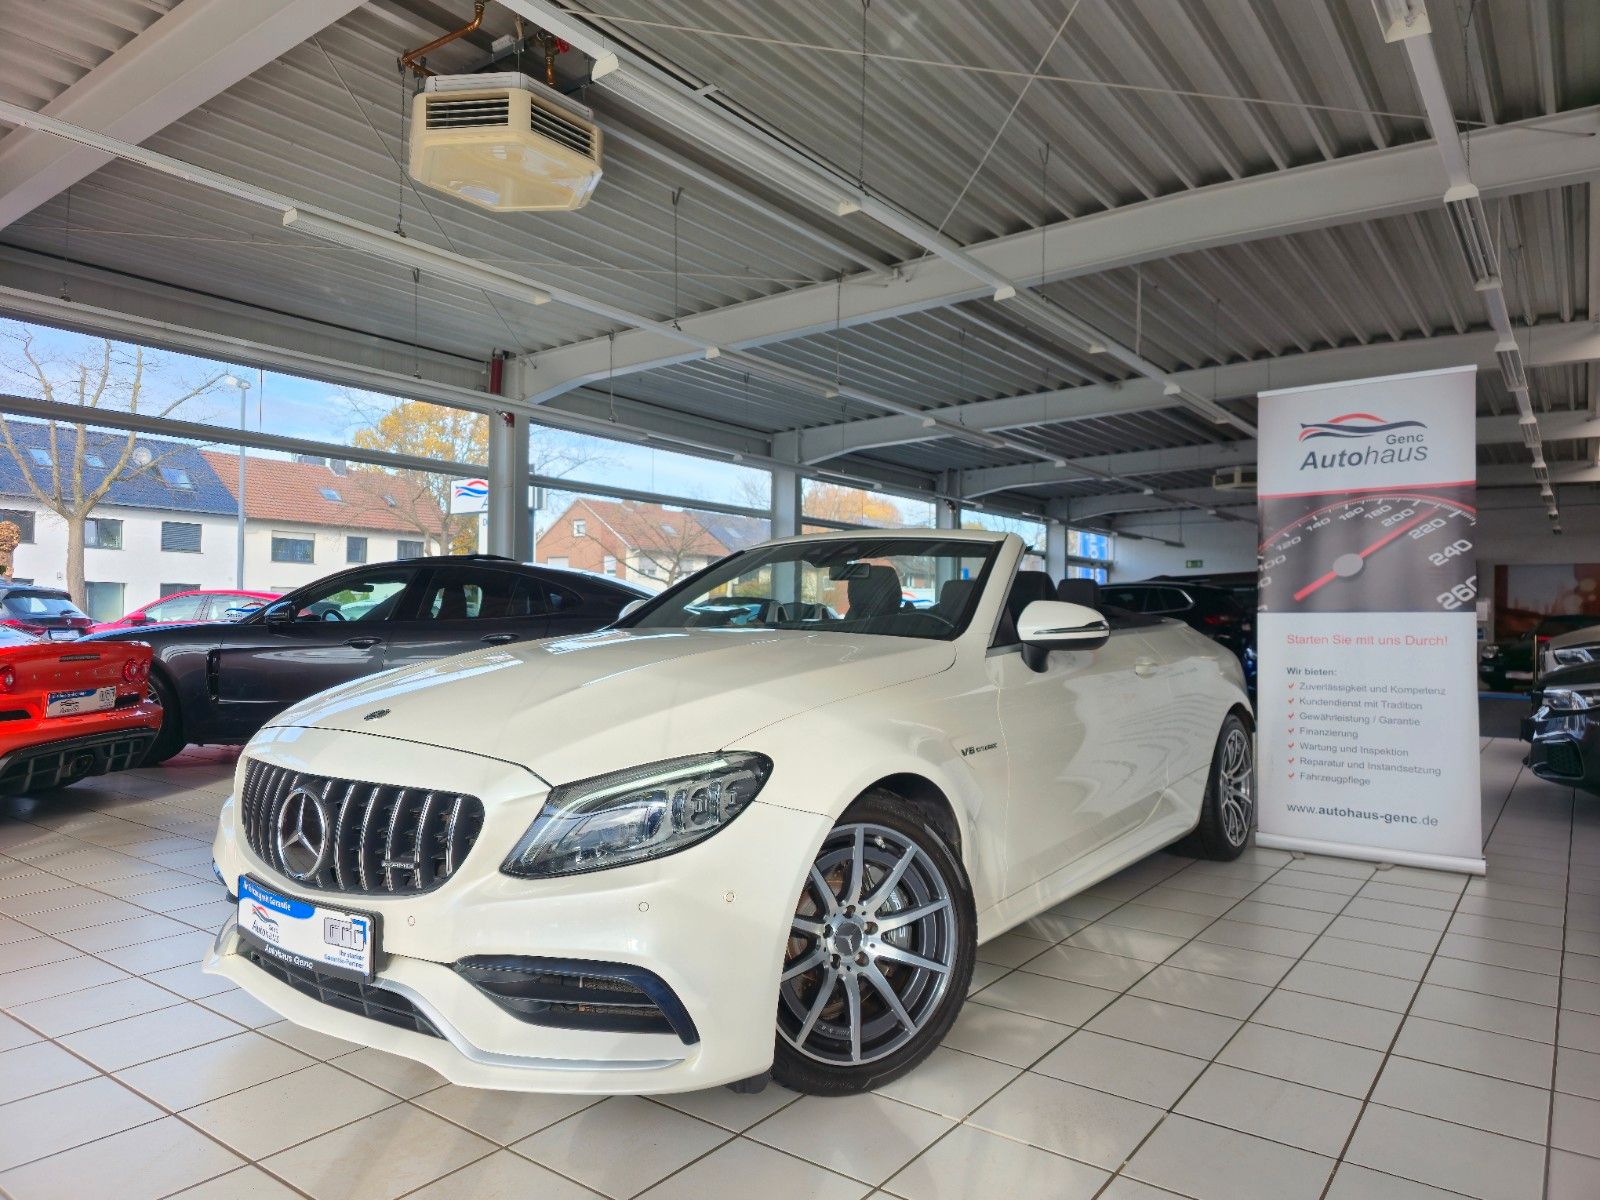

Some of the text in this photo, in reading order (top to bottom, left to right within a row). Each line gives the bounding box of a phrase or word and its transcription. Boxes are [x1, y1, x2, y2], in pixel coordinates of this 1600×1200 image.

[1386, 433, 1424, 445] Genc
[1300, 445, 1428, 470] Autohaus
[1364, 505, 1392, 519] 180
[1381, 508, 1415, 527] 200
[1305, 517, 1330, 531] 140
[1408, 518, 1447, 539] 220
[1275, 536, 1302, 551] 120
[1428, 539, 1473, 566] 240
[1287, 634, 1448, 646] Starten Sie mit uns Durch!
[1287, 667, 1337, 677] Wir bieten:
[1299, 682, 1446, 696] Zuverlässigkeit und Kompetenz
[1299, 698, 1423, 710] Kundendienst mit Tradition
[1299, 712, 1370, 725] Gewährleistung
[1378, 716, 1420, 726] Garantie
[1299, 727, 1359, 740] Finanzierung
[1299, 742, 1409, 758] Wartung und Inspektion
[1300, 757, 1441, 776] Reparatur und Instandsetzung
[1299, 772, 1371, 786] Fahrzeugpflege
[1287, 803, 1438, 827] www.autohaus-genc.de
